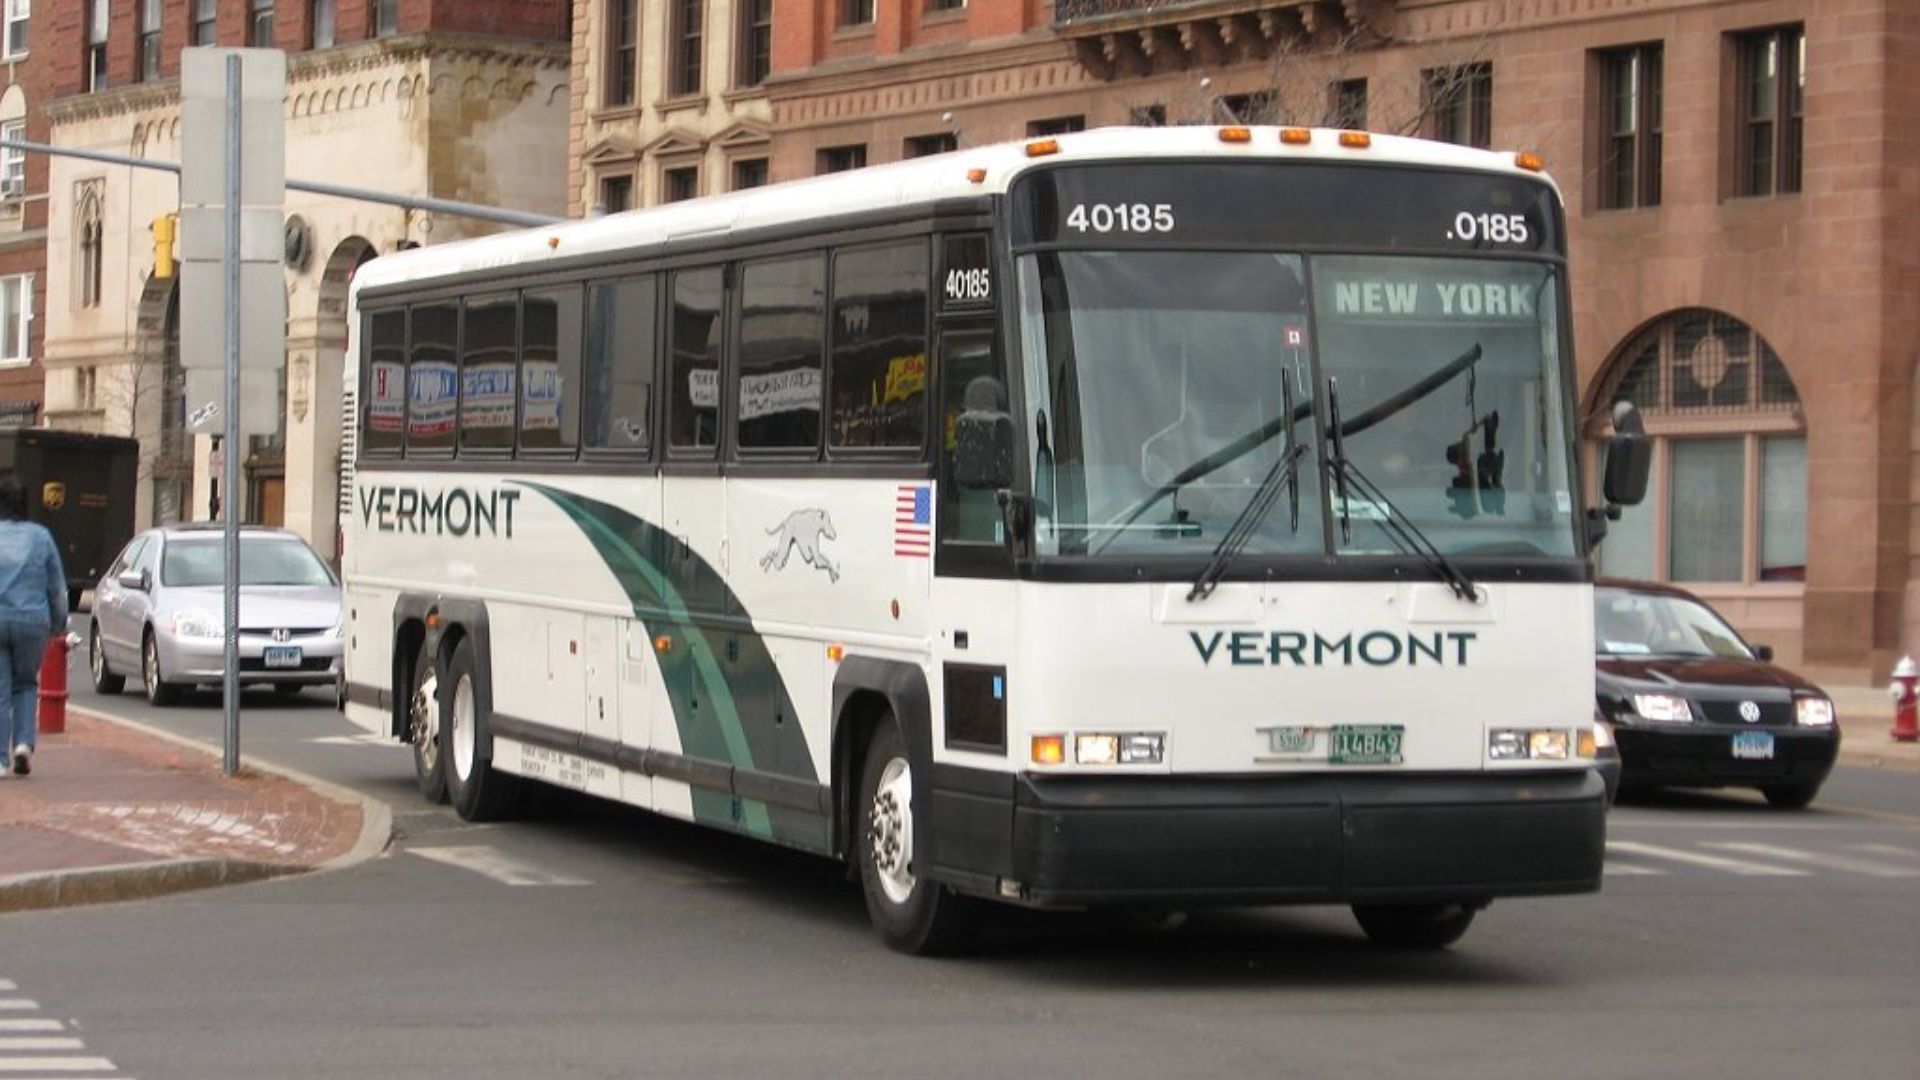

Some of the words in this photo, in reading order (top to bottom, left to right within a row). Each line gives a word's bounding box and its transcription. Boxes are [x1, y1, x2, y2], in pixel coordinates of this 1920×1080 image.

[1066, 203, 1175, 232] 40185
[946, 268, 990, 298] 40185
[1335, 282, 1418, 314] NEW
[1437, 284, 1533, 315] YORK
[360, 487, 520, 538] VERMONT
[1190, 631, 1477, 666] VERMONT
